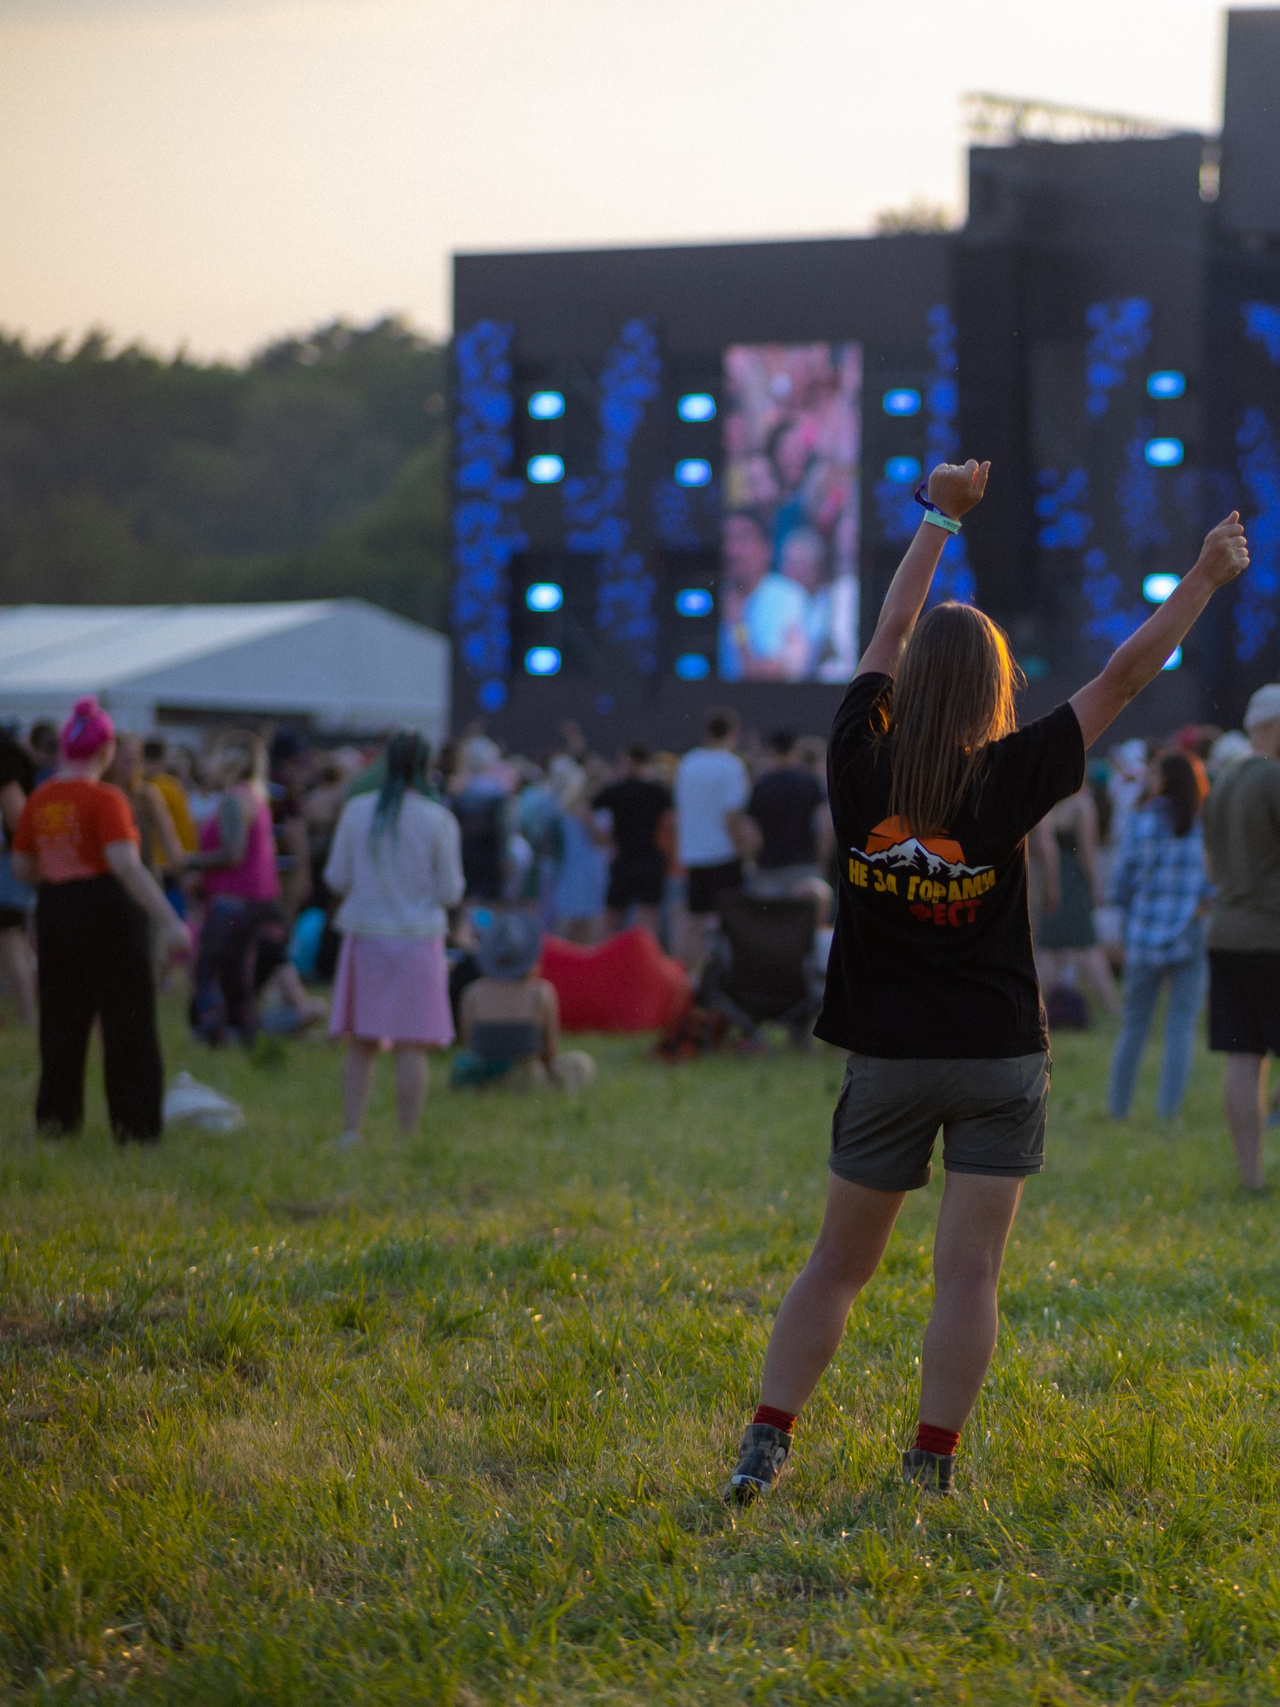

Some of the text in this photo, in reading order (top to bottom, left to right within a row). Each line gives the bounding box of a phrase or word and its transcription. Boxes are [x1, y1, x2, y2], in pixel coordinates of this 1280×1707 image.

[849, 858, 996, 904] НЕ ЗА ГОРАМИ
[910, 899, 982, 928] ФЕСТ
